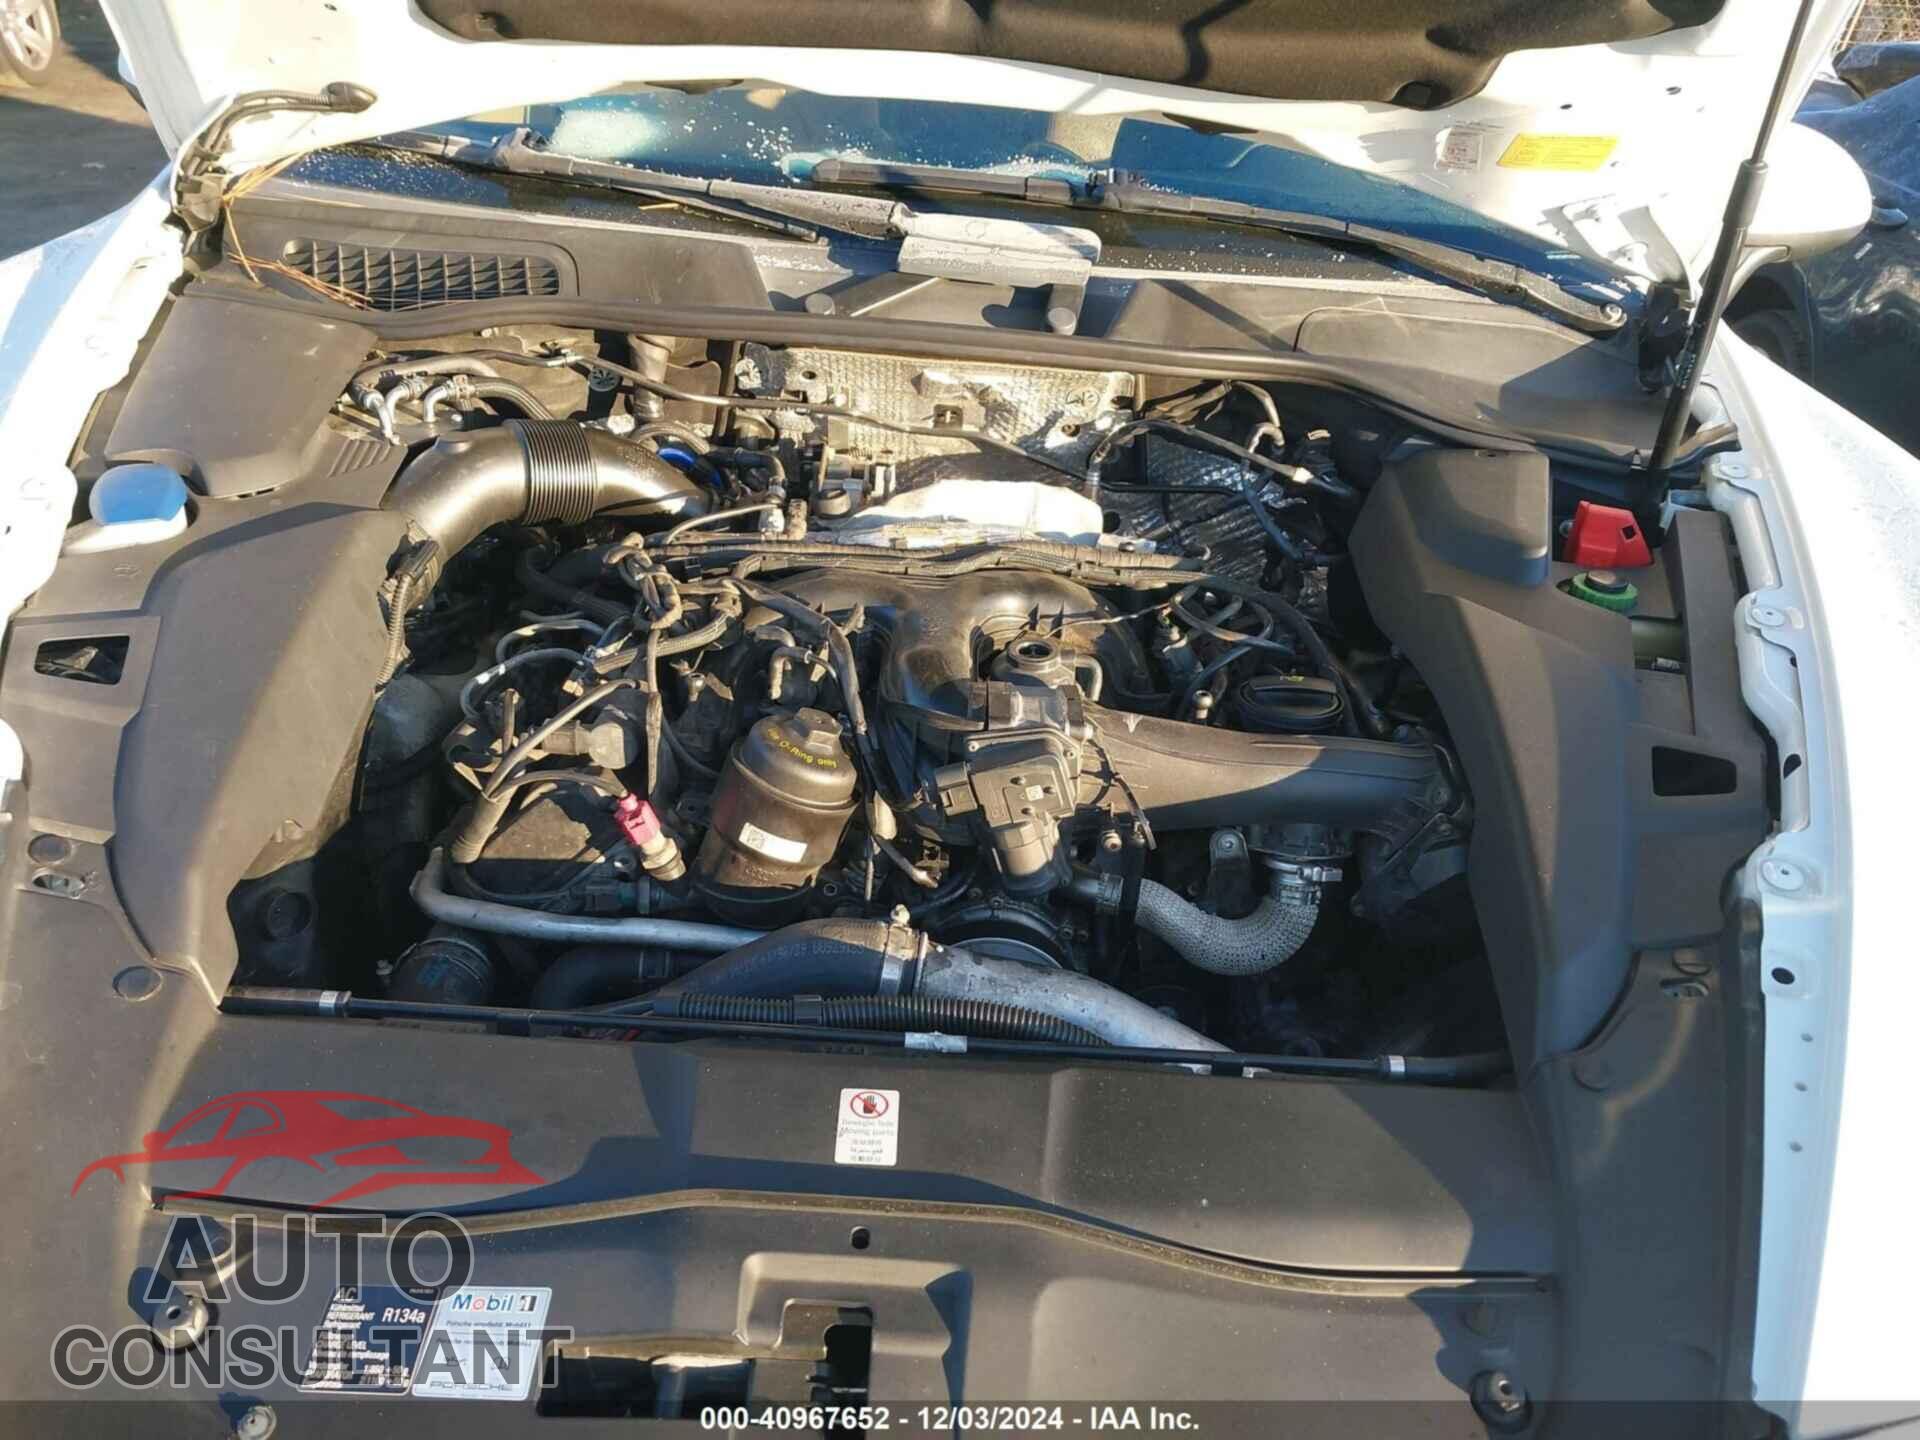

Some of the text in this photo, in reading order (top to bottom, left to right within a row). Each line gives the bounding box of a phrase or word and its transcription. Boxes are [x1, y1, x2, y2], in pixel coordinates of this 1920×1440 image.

[451, 1294, 538, 1312] Mobil 1
[381, 1306, 427, 1325] R134a
